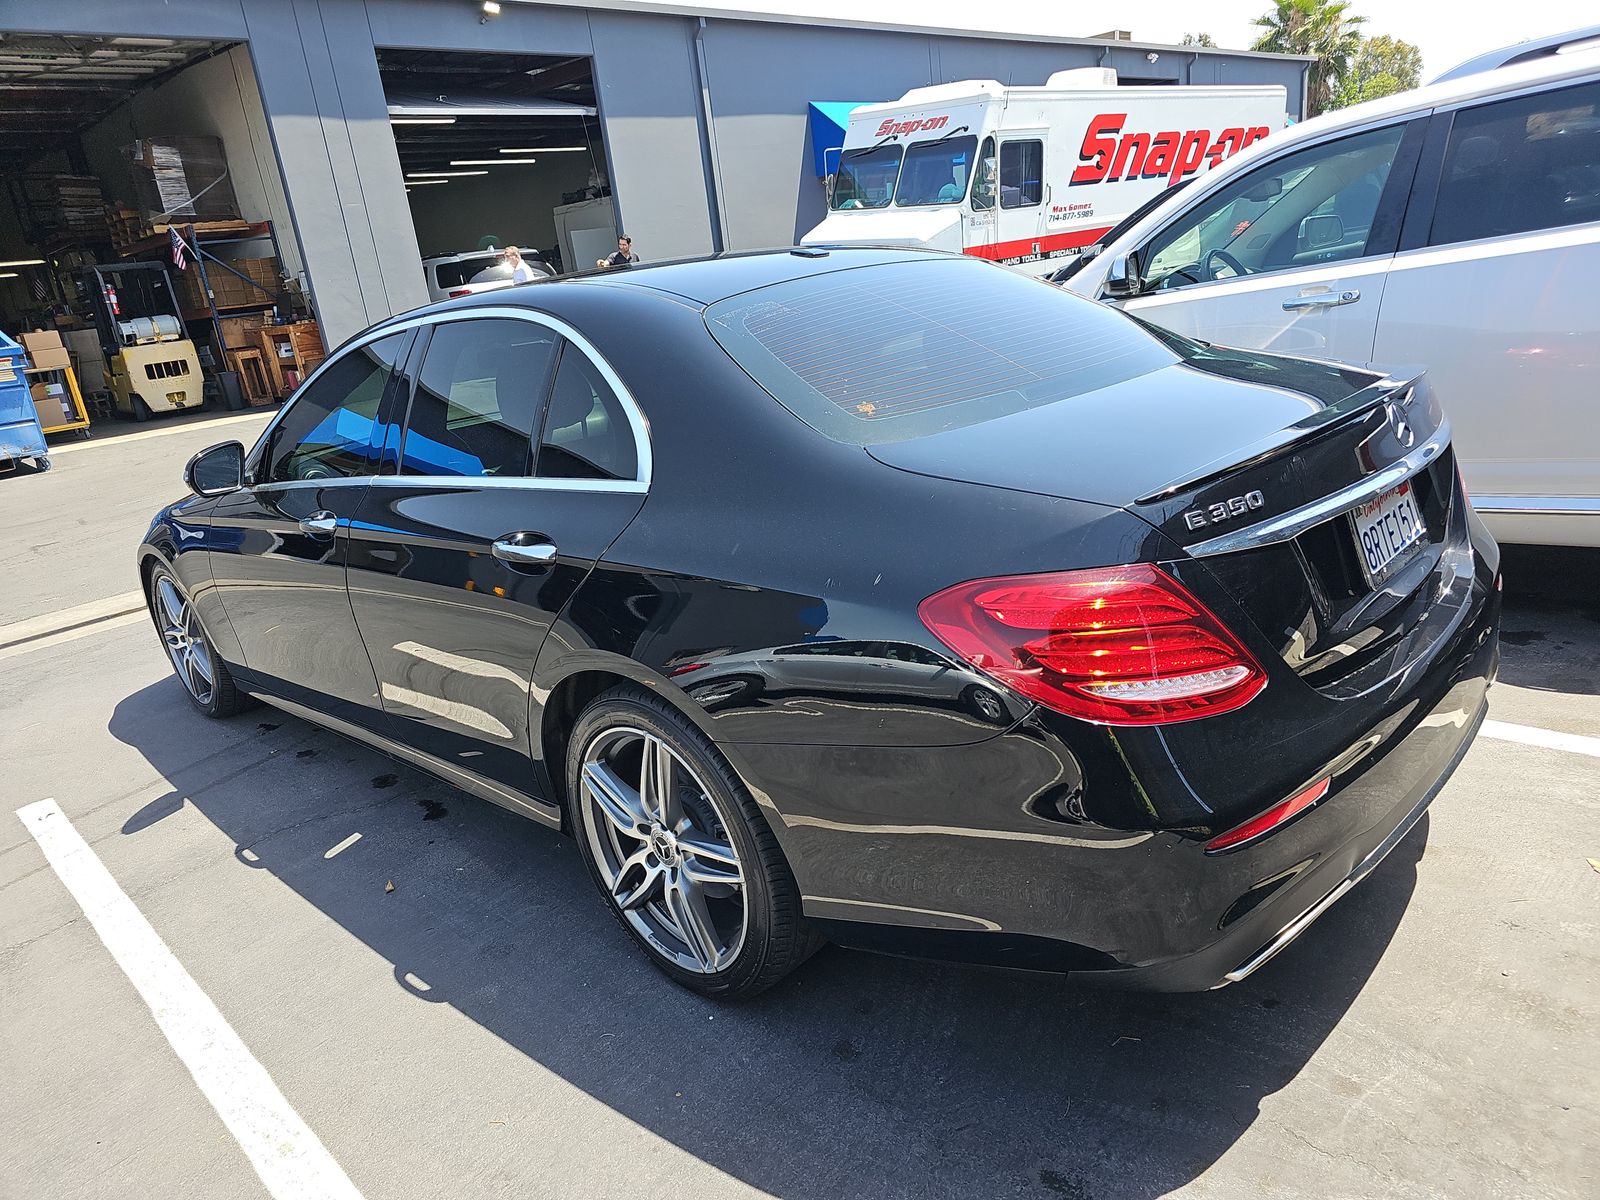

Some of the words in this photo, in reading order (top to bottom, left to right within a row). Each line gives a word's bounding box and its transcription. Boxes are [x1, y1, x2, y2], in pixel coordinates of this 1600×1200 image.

[875, 115, 949, 137] Snap-on
[1052, 204, 1068, 214] Max
[1068, 202, 1092, 212] Gomez
[1002, 256, 1020, 266] HAND
[1049, 246, 1078, 258] SPECIALTY
[1209, 490, 1265, 523] 350
[1362, 499, 1421, 571] 8RTE151
